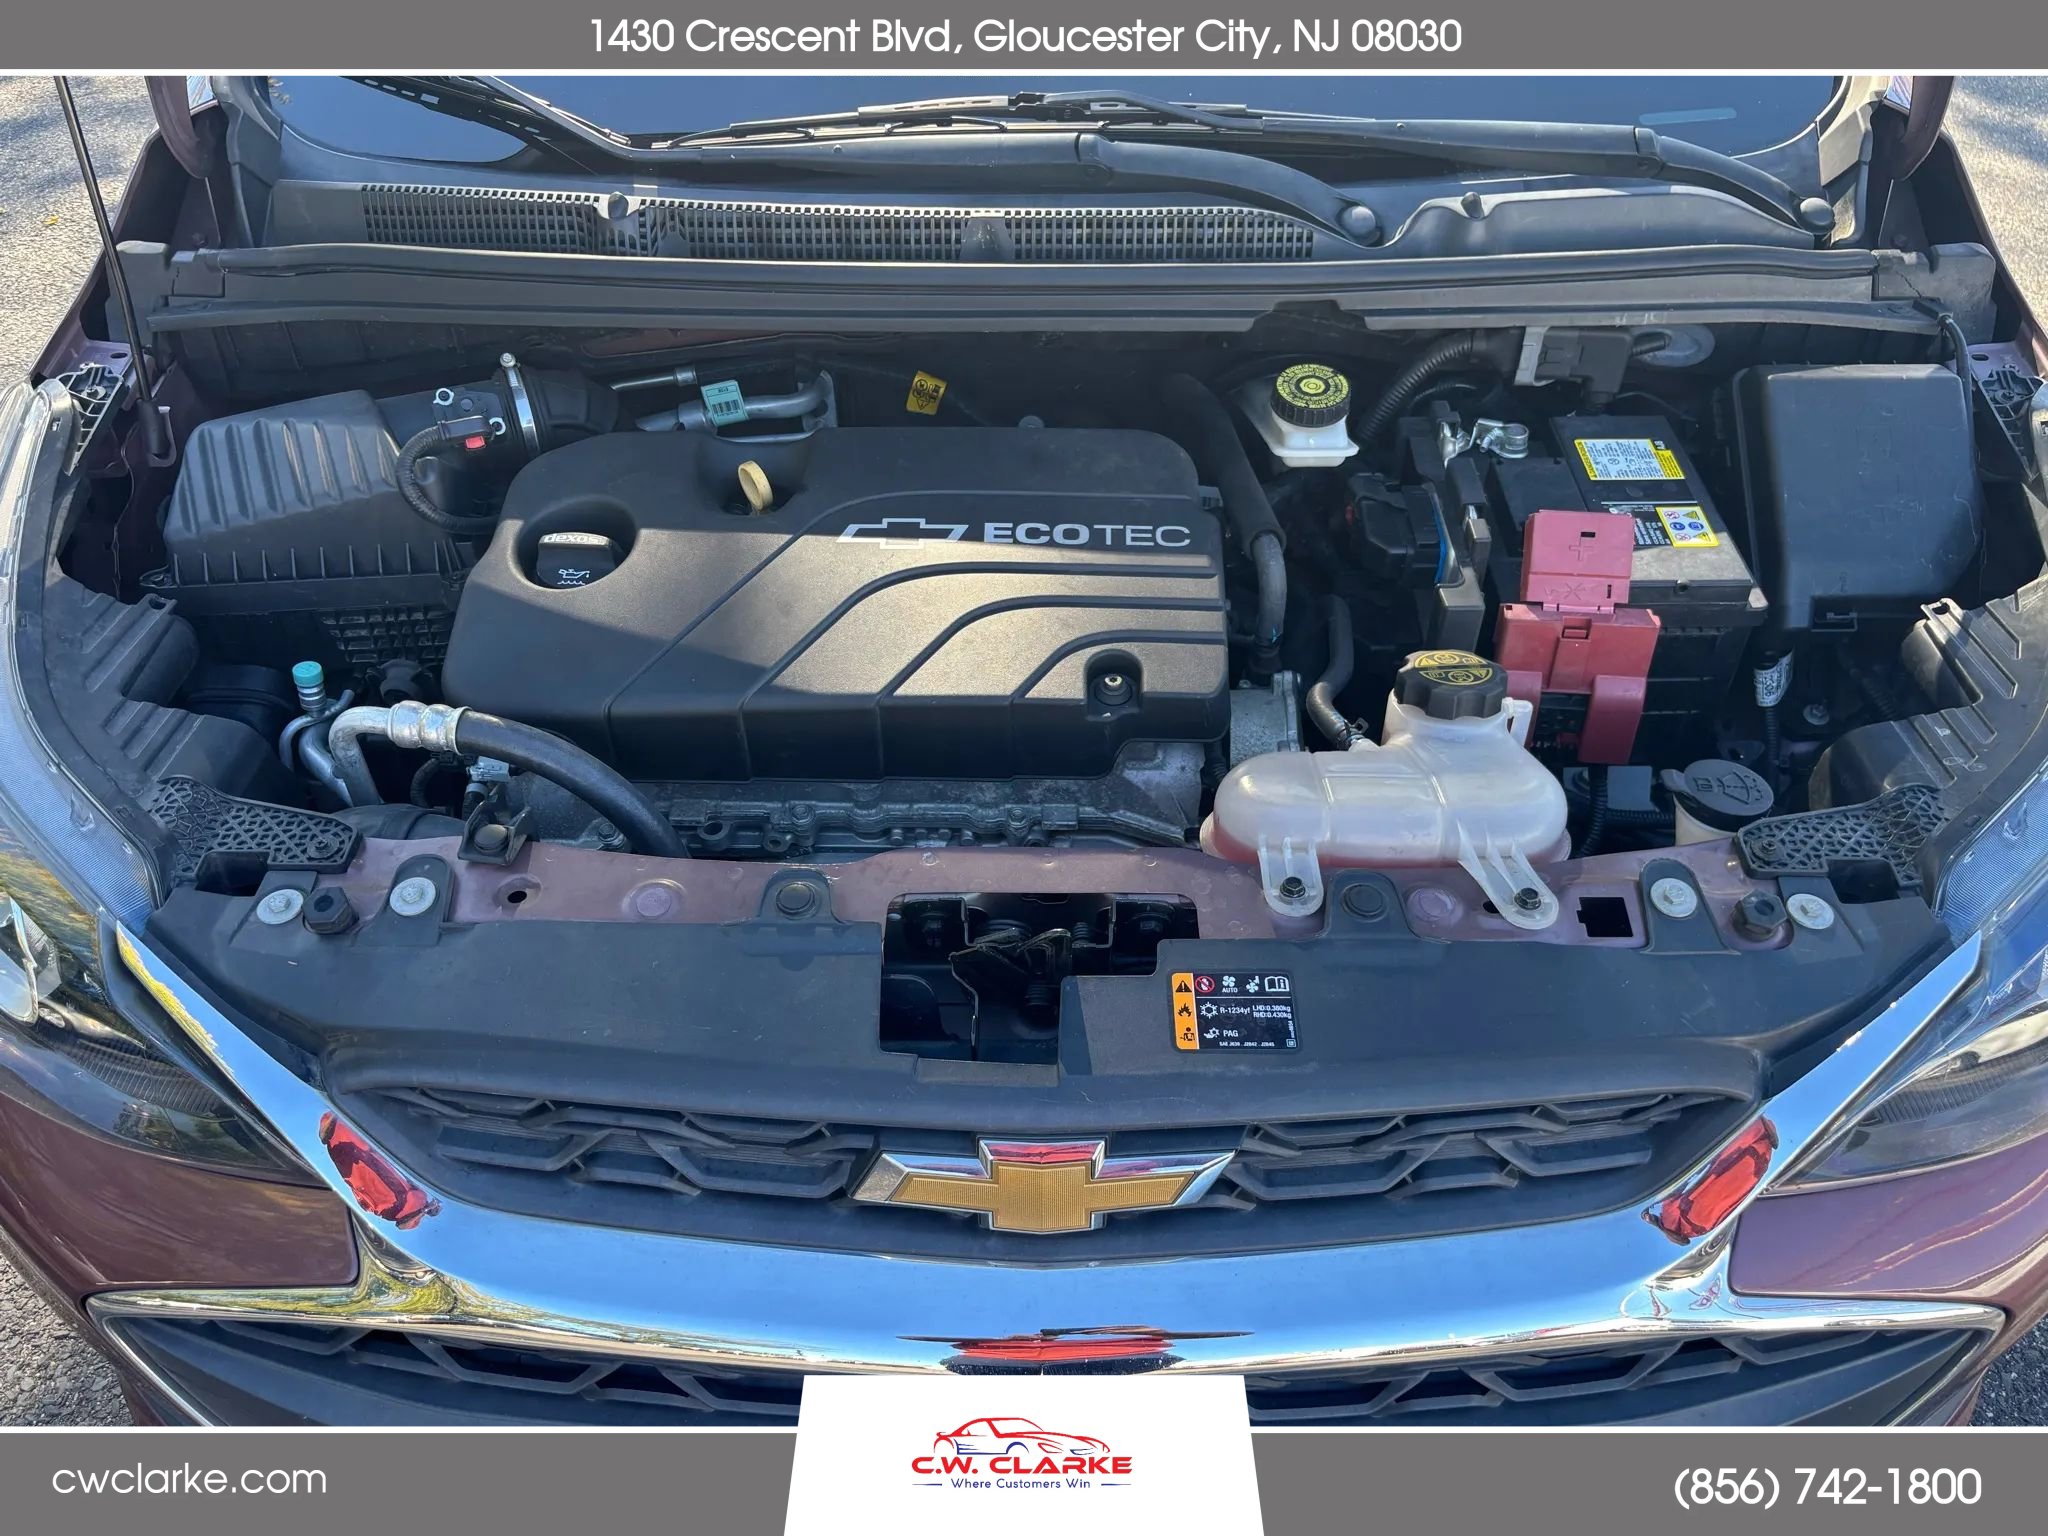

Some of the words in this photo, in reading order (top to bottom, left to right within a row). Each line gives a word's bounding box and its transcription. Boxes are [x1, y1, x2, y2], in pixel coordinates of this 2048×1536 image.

[984, 522, 1191, 547] ECOTEC
[1220, 1006, 1250, 1015] R-1234yf
[1223, 1029, 1239, 1037] PAG
